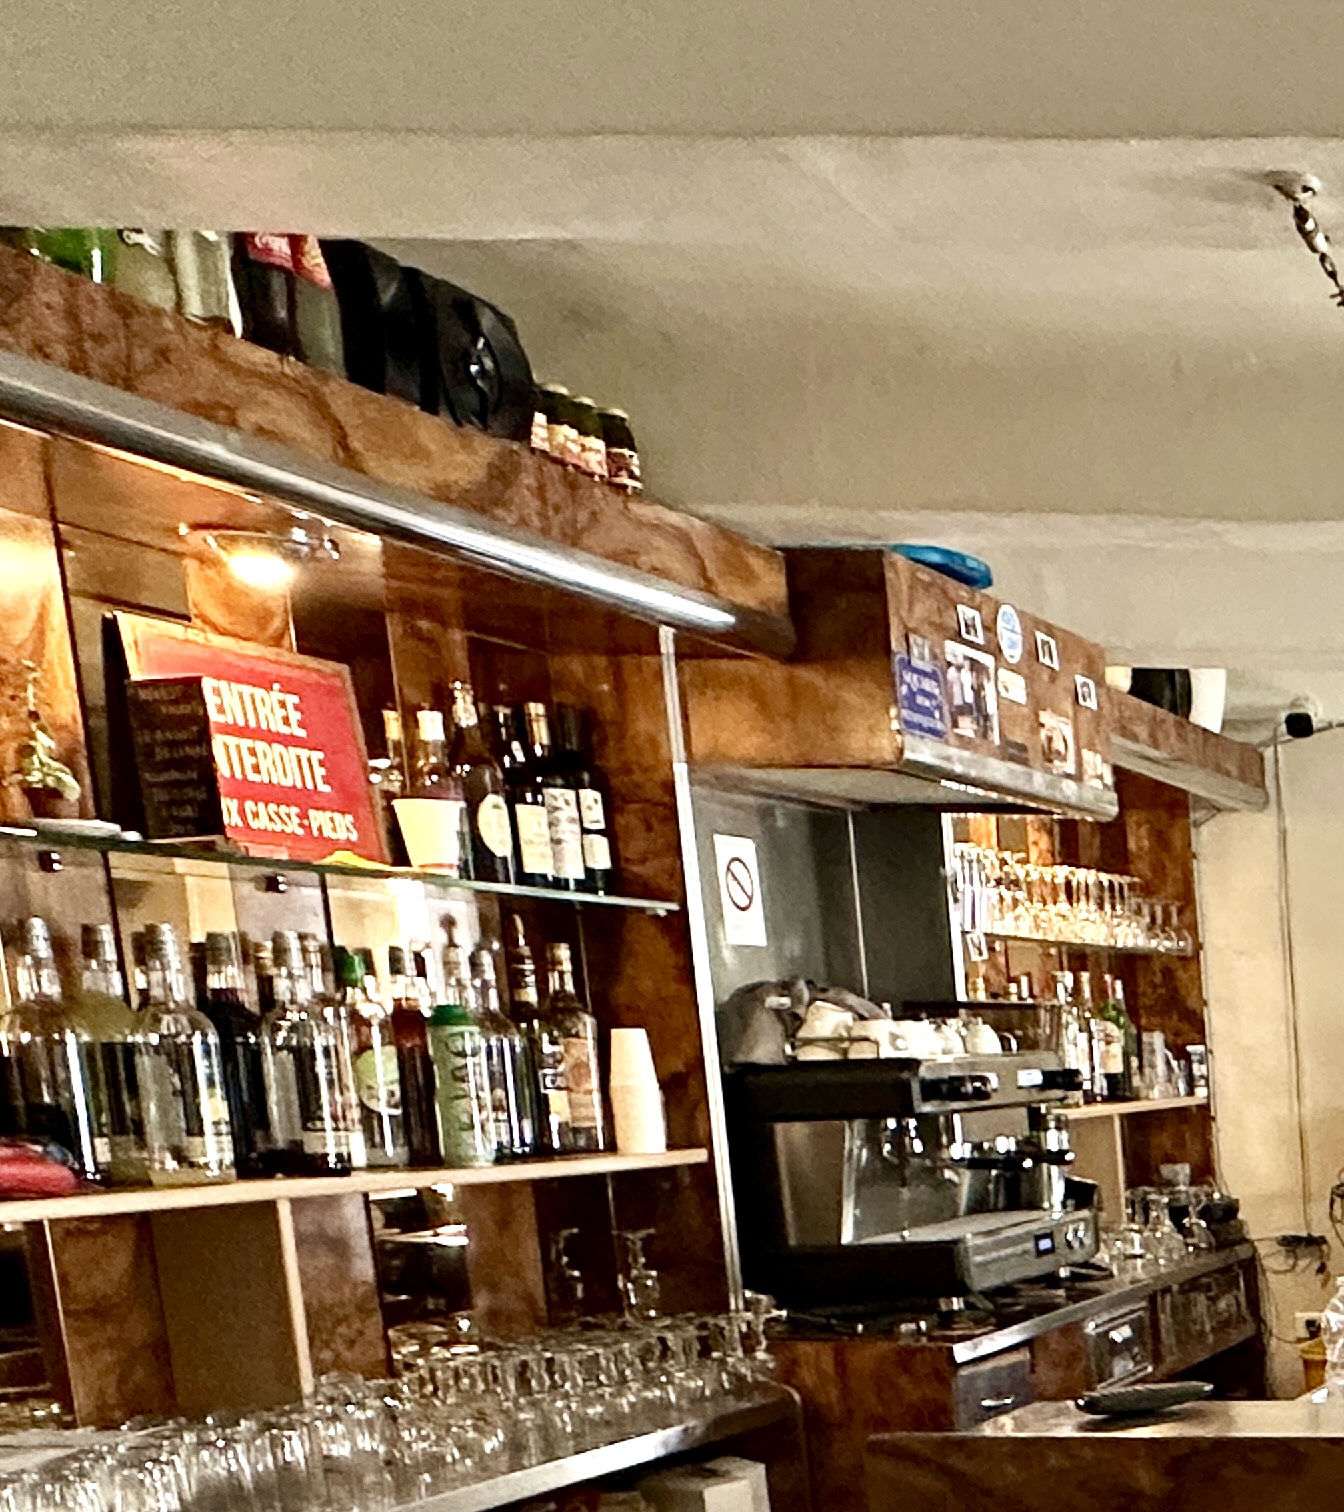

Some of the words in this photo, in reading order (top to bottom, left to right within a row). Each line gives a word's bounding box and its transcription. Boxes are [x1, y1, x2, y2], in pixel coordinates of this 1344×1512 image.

[202, 676, 308, 738] ENTRÉE
[212, 733, 332, 793] NTERDITE
[244, 800, 359, 842] CASSE-PIEDS
